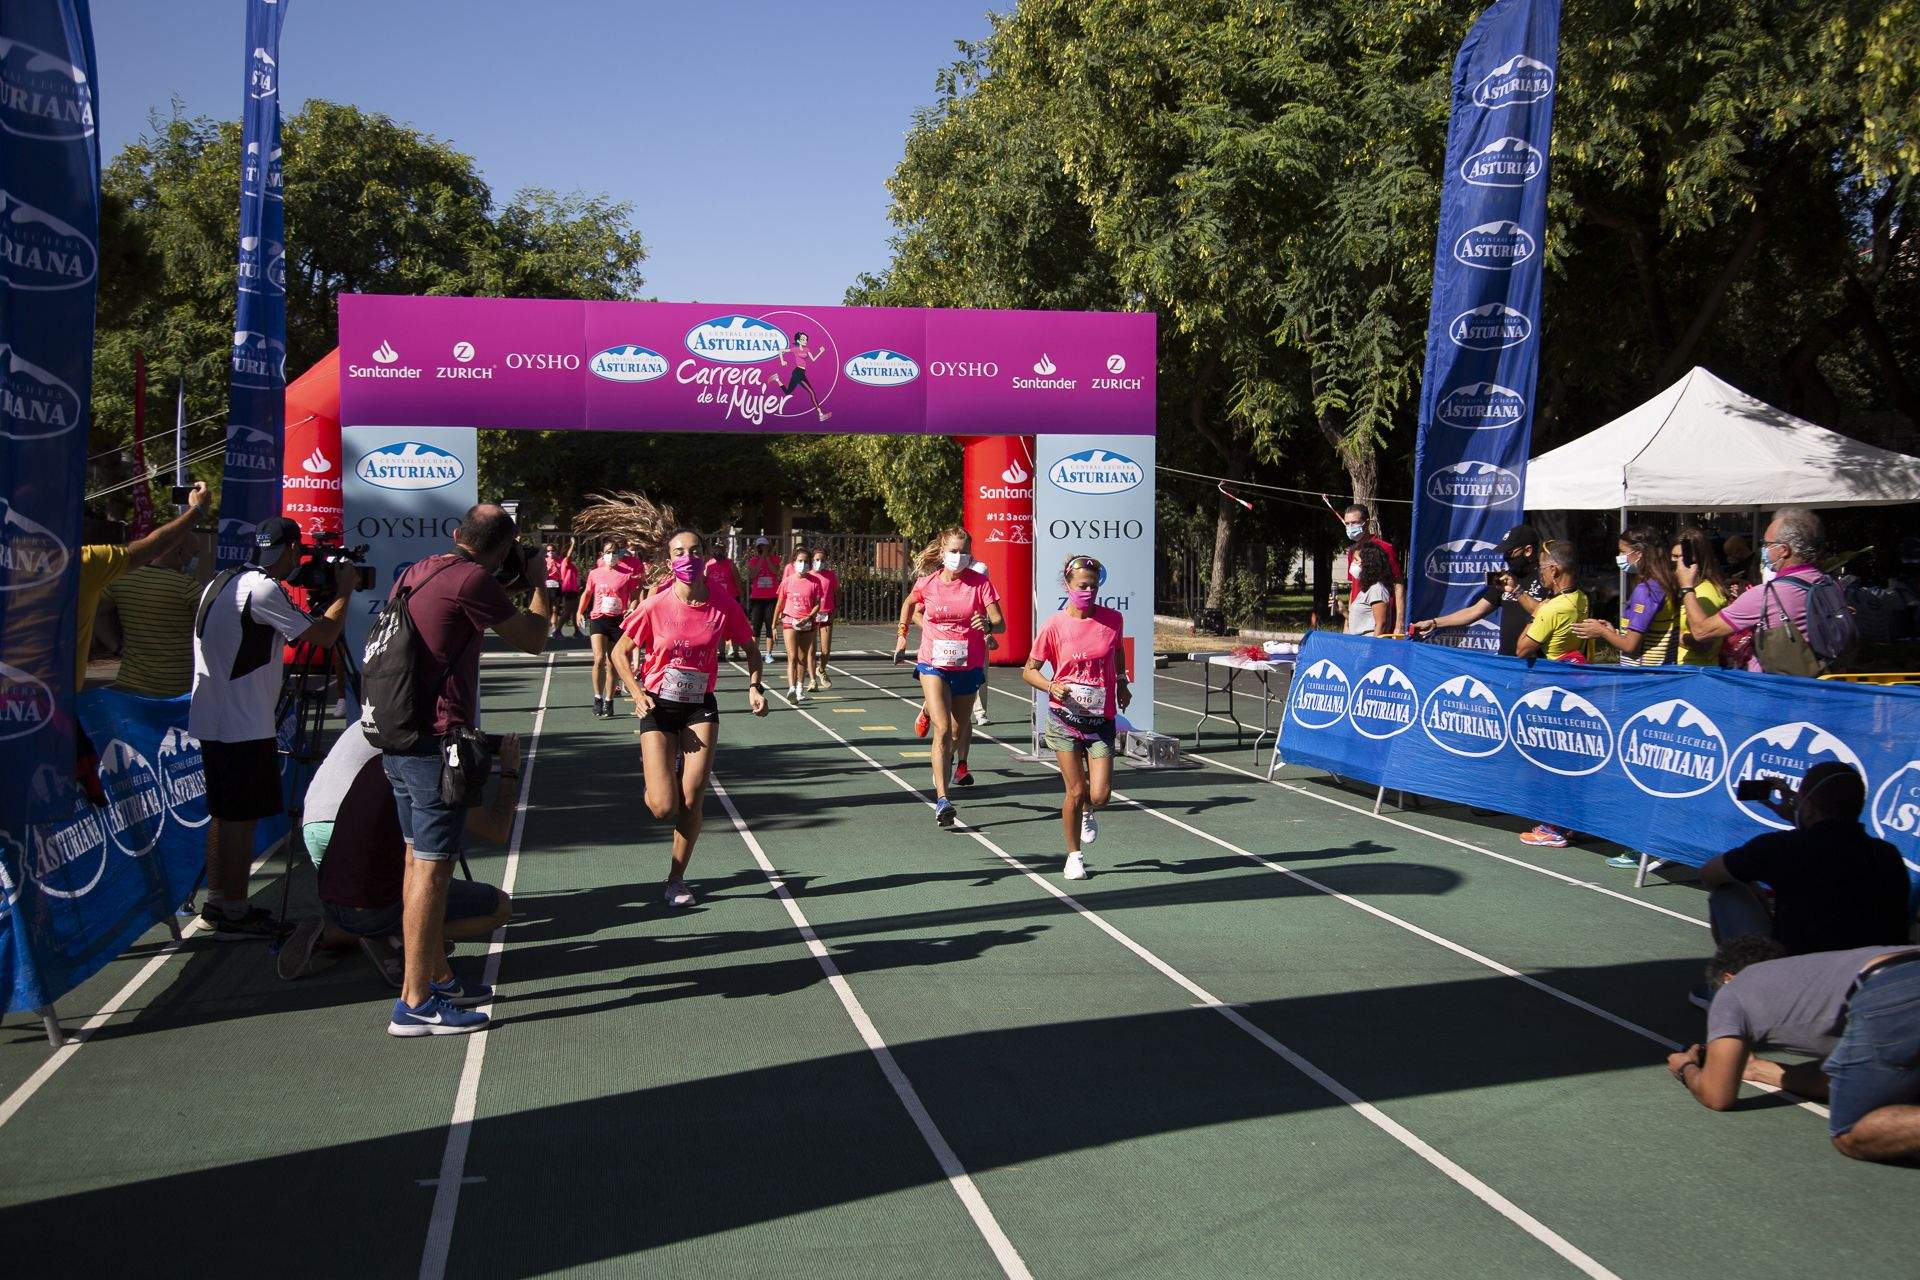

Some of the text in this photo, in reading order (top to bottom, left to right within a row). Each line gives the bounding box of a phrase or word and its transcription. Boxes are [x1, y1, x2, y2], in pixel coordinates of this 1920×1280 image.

[693, 332, 781, 352] ASTURIANA
[505, 353, 580, 370] OYSHO
[596, 358, 663, 373] ASTURIANA
[850, 362, 914, 377] ASTURIANA
[929, 361, 998, 378] OYSHO
[348, 364, 422, 379] Santander
[436, 367, 493, 379] ZURICH
[676, 358, 762, 385] Carrera
[1012, 376, 1077, 390] Santander
[1091, 378, 1141, 390] ZURICH
[697, 382, 793, 425] de la Mujer
[1442, 399, 1519, 418] ASTURIANA
[364, 459, 457, 479] ASTURIANA
[1056, 465, 1137, 484] ASTURIANA
[282, 474, 343, 490] Santand
[1432, 477, 1514, 496] ASTURIANA
[358, 516, 457, 539] OYSHO
[1049, 519, 1143, 540] OYSHO
[1057, 597, 1129, 611] ZICH
[673, 640, 690, 648] WE
[676, 681, 694, 690] 016
[1366, 688, 1411, 701] CENTRAL LECHERA
[1076, 695, 1093, 704] 016
[1295, 683, 1345, 714] ASTURIANA
[1352, 688, 1410, 724] ASTURIANA
[1443, 699, 1498, 716] CENTRAL LECHERA
[1427, 699, 1503, 741] ASTURIANA
[1525, 713, 1602, 731] CENTRAL LECHERA
[1516, 713, 1606, 758] ASTURIANA
[1643, 729, 1717, 752] CENTRAL LECHERA
[1624, 728, 1716, 782] ASTURIANA
[1760, 752, 1805, 770] CENTRAL
[105, 786, 163, 835] ASTURIANA
[33, 813, 104, 879] ASTURIANA
